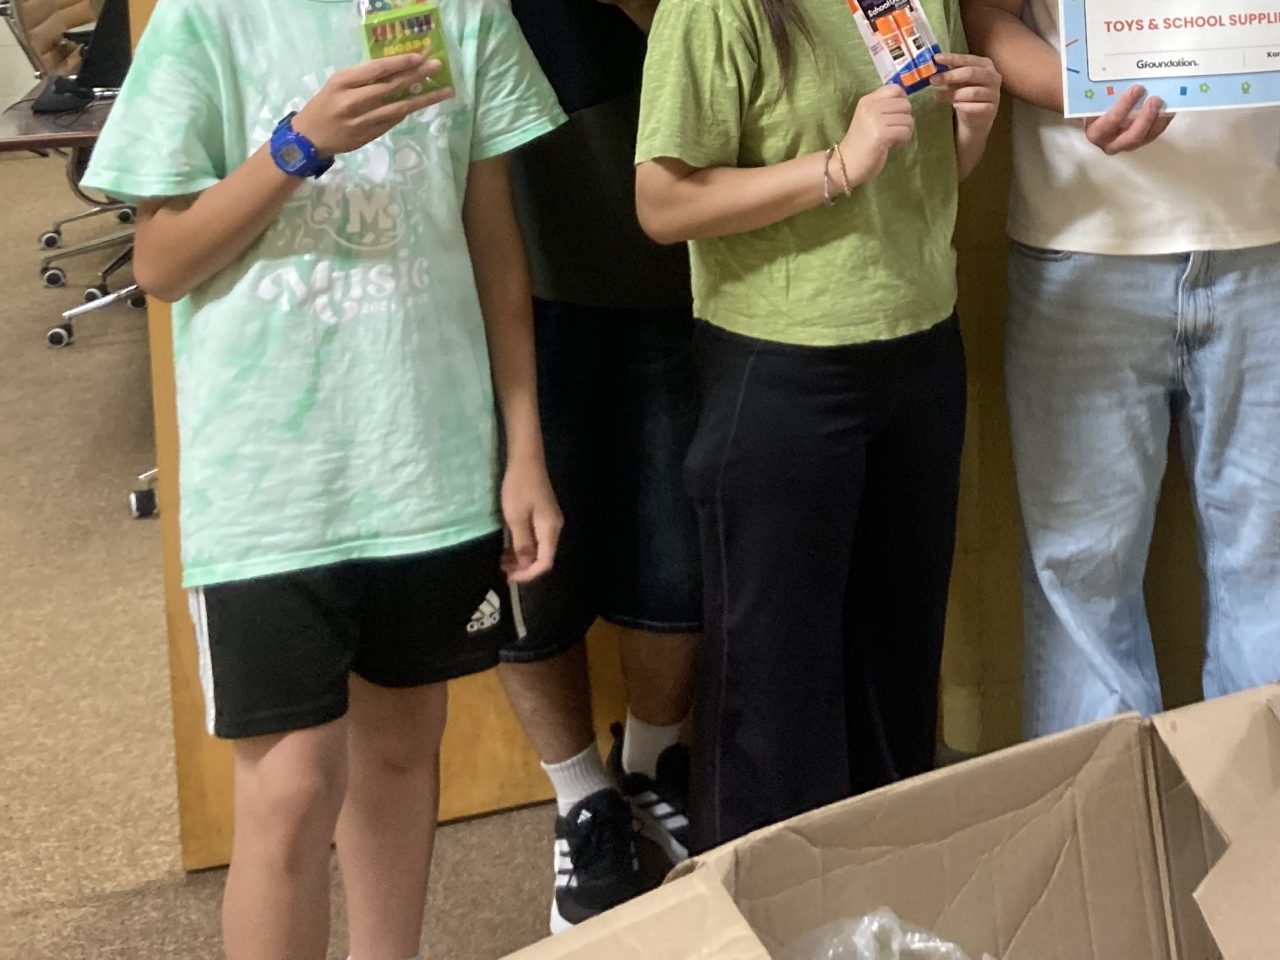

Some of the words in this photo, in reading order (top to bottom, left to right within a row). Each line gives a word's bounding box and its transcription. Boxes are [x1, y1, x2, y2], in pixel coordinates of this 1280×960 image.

[868, 0, 890, 17] School
[1104, 18, 1145, 33] TOYS
[1148, 18, 1159, 31] &
[1163, 15, 1226, 30] SCHOOL
